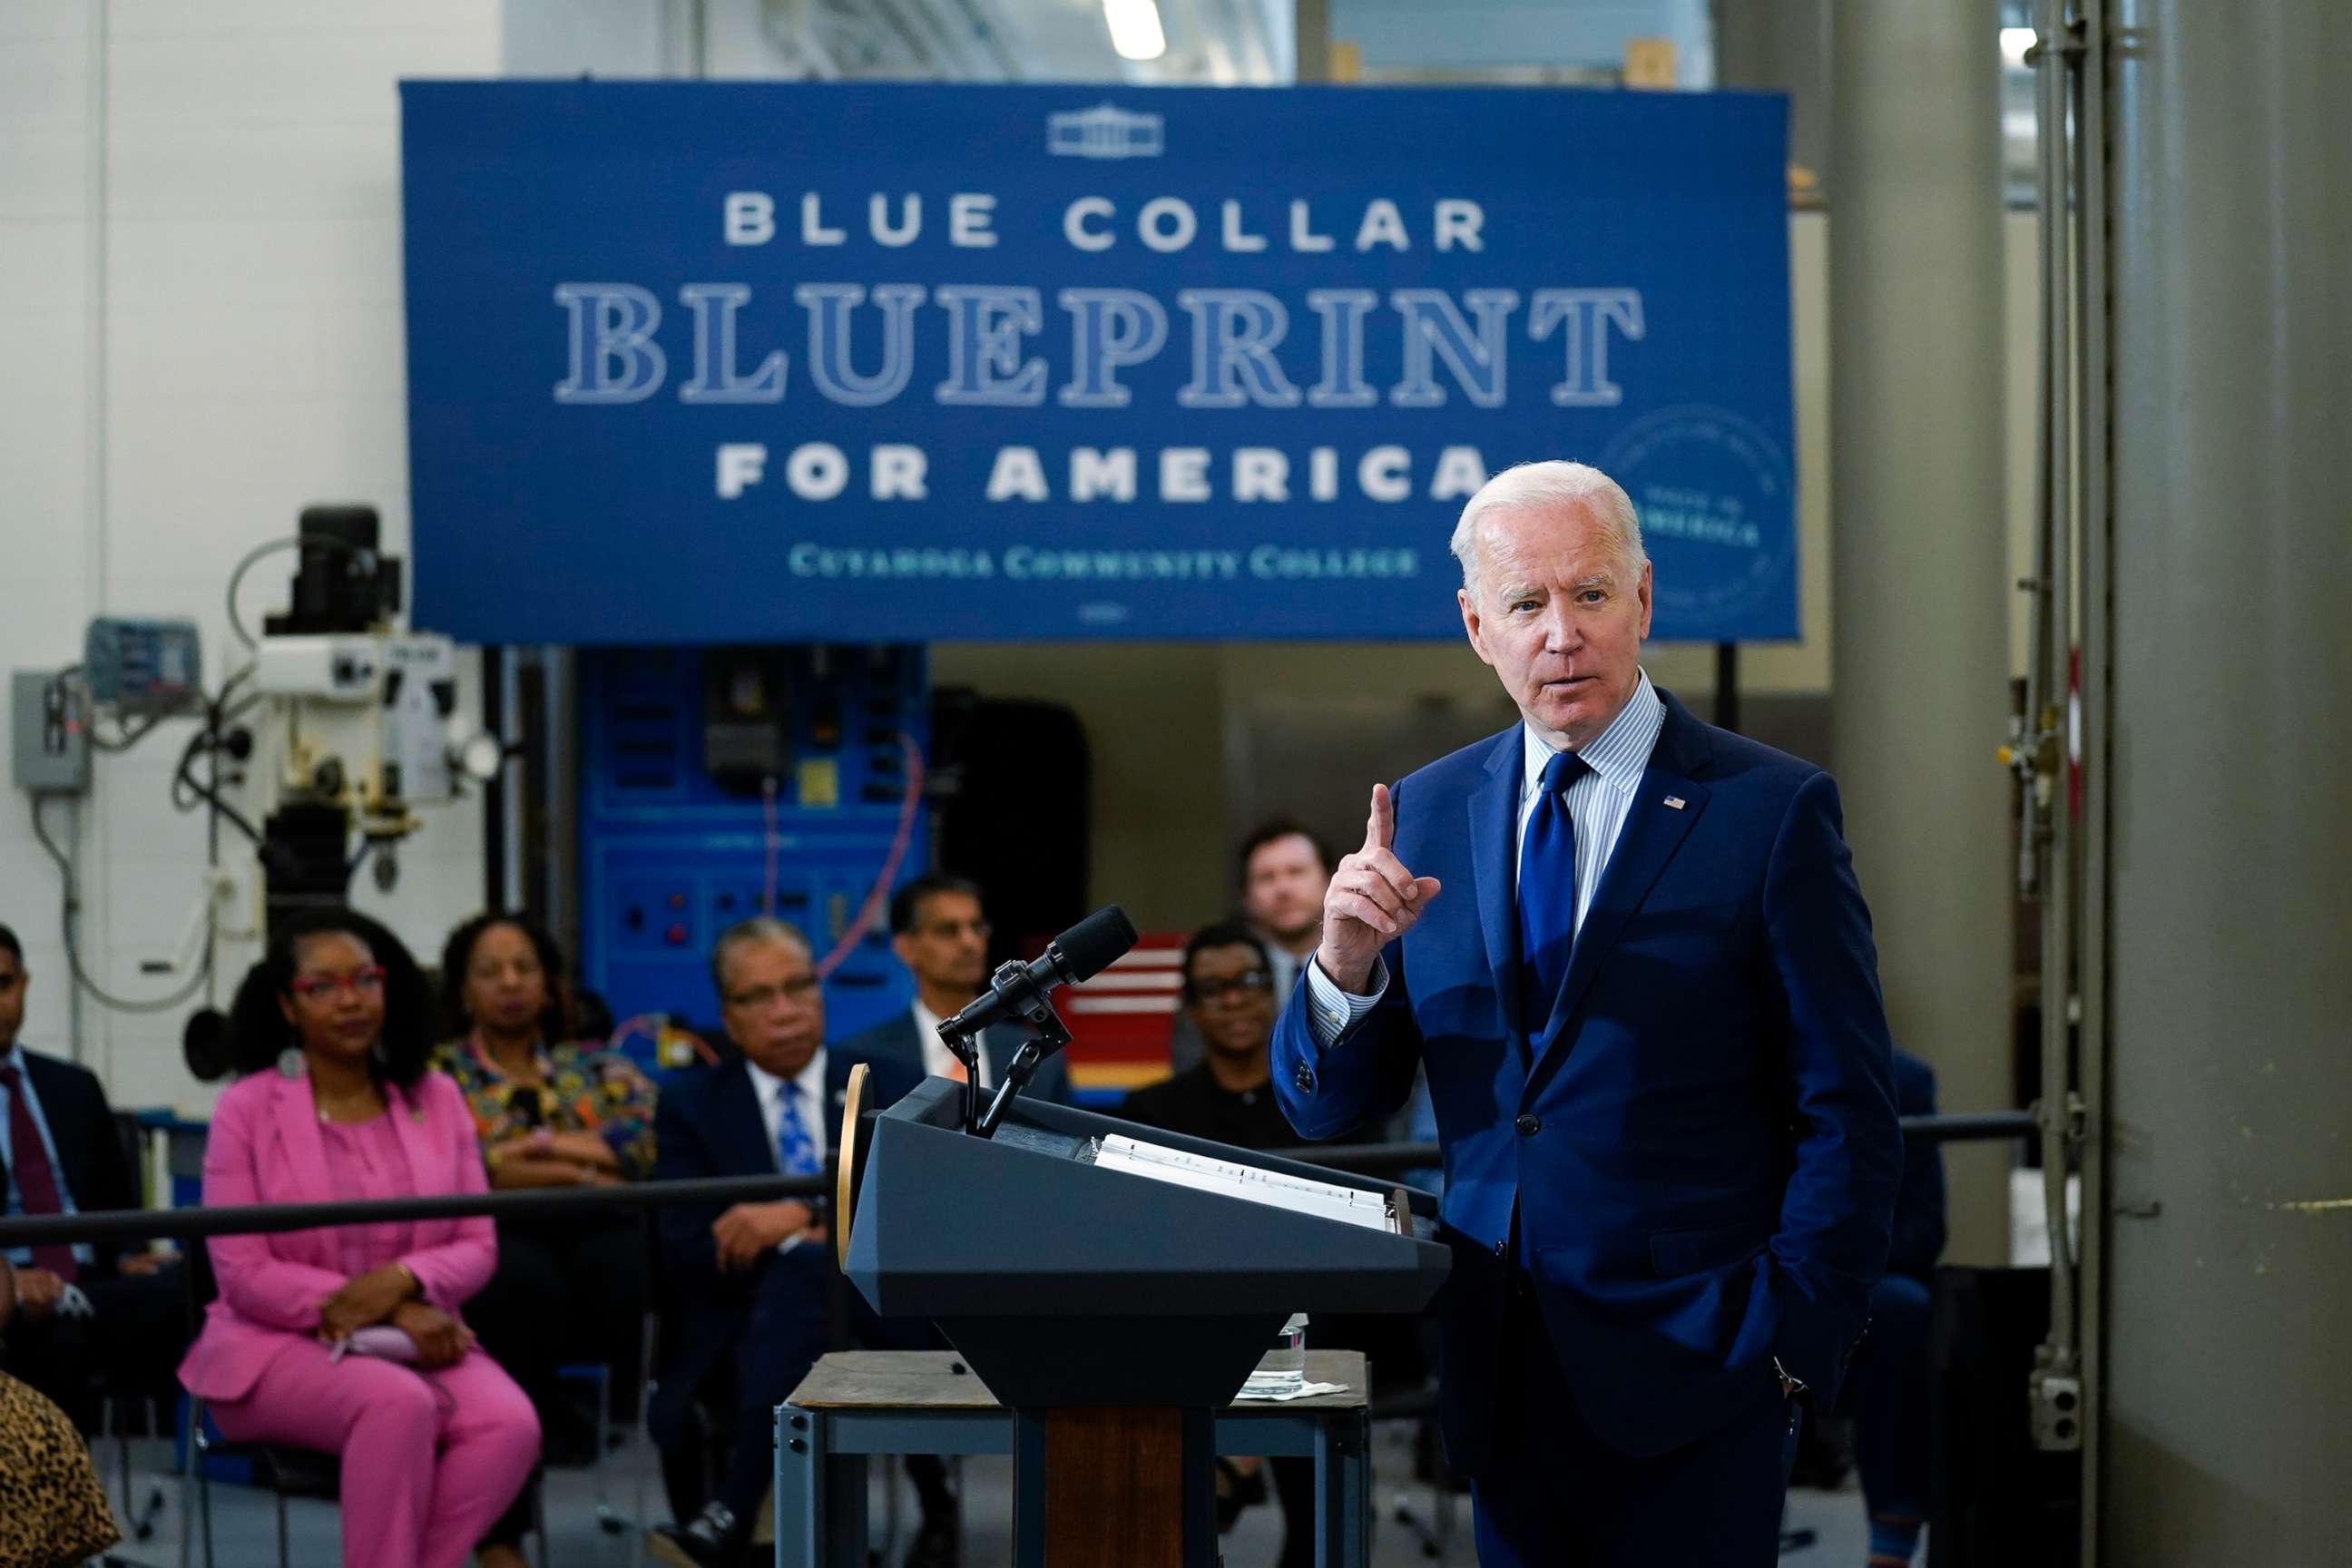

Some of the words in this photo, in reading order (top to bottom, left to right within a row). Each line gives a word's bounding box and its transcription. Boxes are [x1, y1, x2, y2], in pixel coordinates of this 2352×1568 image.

[724, 191, 998, 248] BLUE
[1063, 197, 1485, 253] COLLAR
[554, 282, 1645, 409] BLUEPRINT
[716, 443, 928, 501] FOR
[986, 445, 1486, 503] AMERICA
